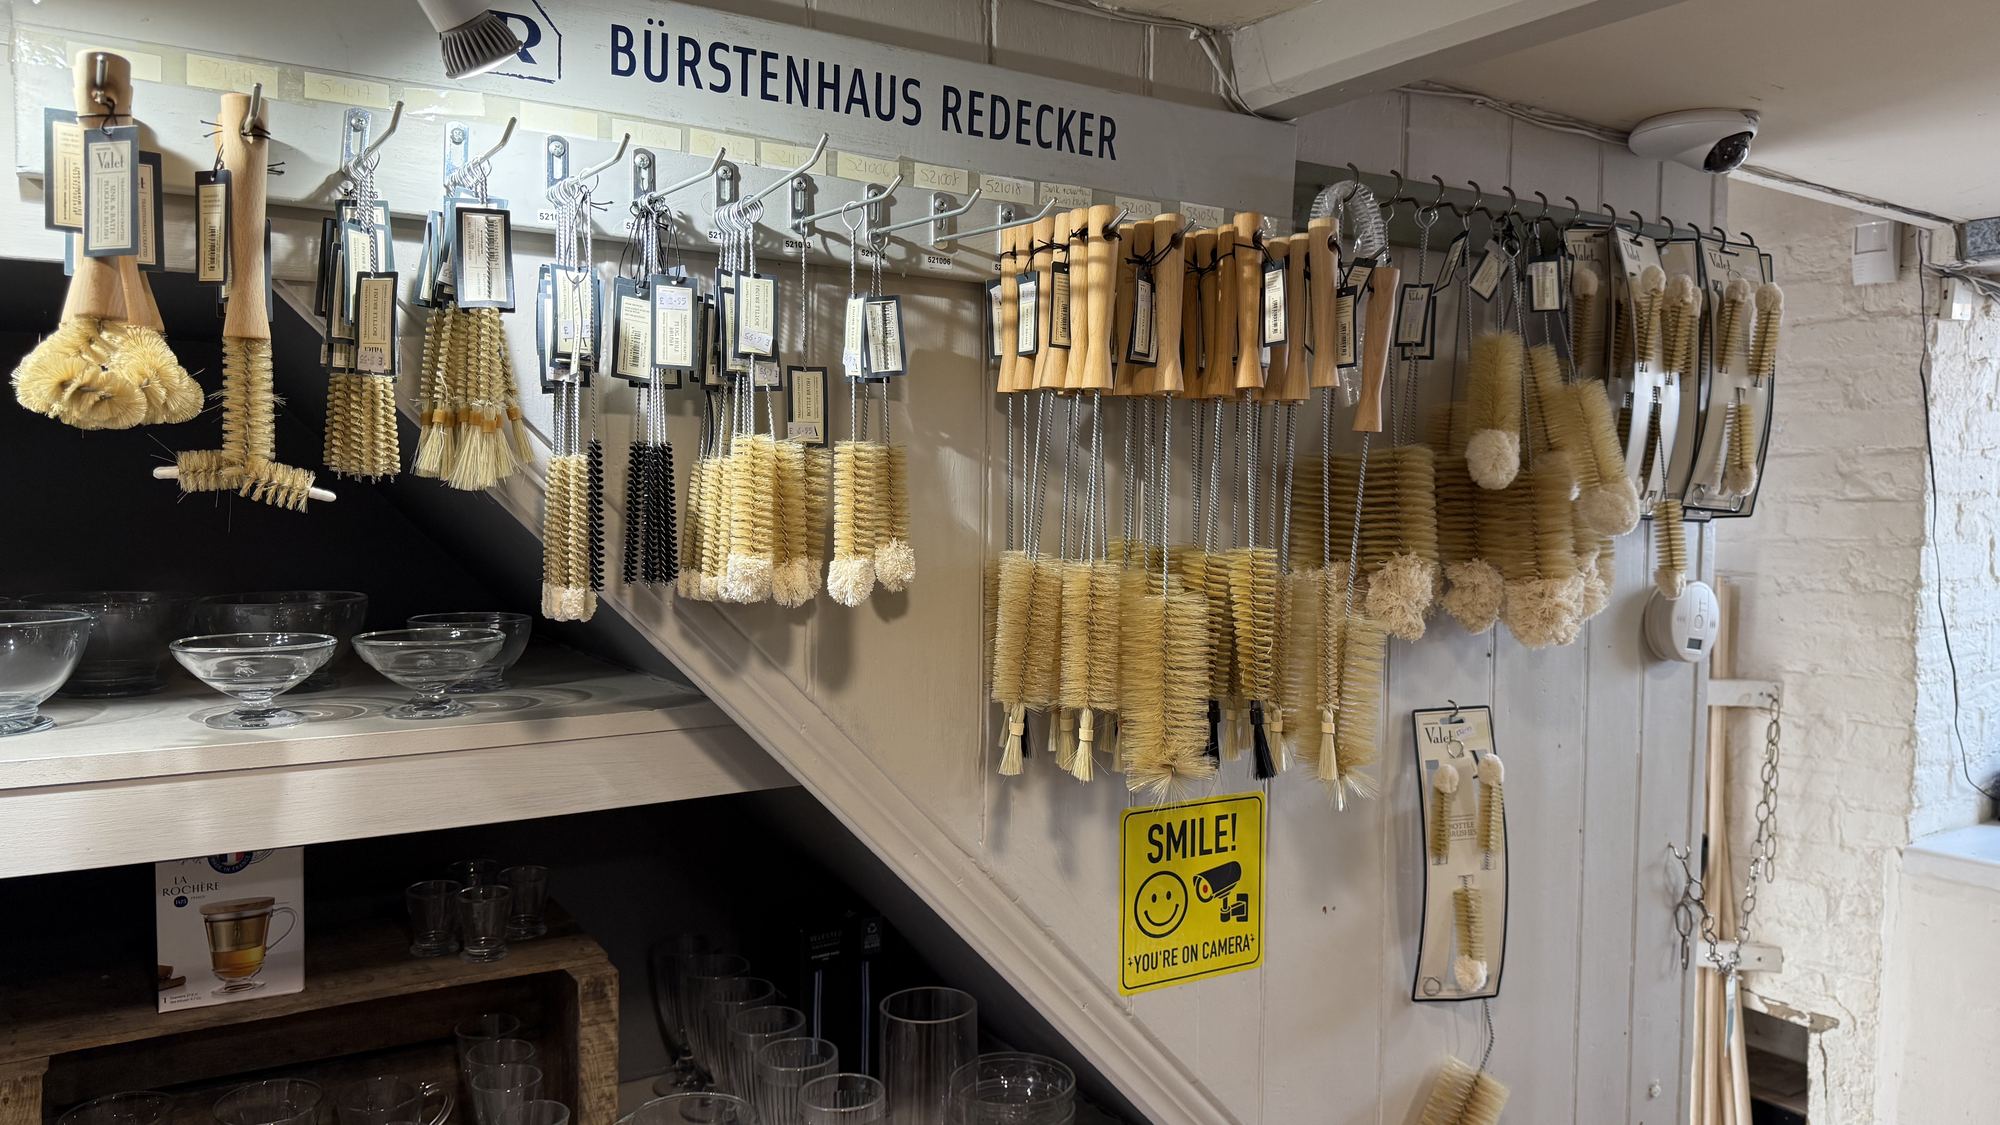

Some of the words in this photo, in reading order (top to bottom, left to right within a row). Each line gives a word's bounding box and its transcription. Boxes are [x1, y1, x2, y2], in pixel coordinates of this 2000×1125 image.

[611, 17, 922, 126] BÜRSTENHAUS
[941, 85, 1117, 161] REDECKER
[96, 151, 125, 169] Valet
[785, 240, 811, 249] 52103
[1572, 244, 1594, 262] Valet
[928, 256, 951, 266] 521006
[1708, 252, 1731, 270] Valet
[1425, 727, 1453, 745] Valet
[1146, 812, 1237, 864] SMILE!
[162, 881, 219, 896] ROCHÈRE
[174, 875, 188, 885] LA
[1133, 947, 1179, 974] YOU'RE
[1181, 944, 1199, 963] ON
[1201, 935, 1251, 960] CAMERA
